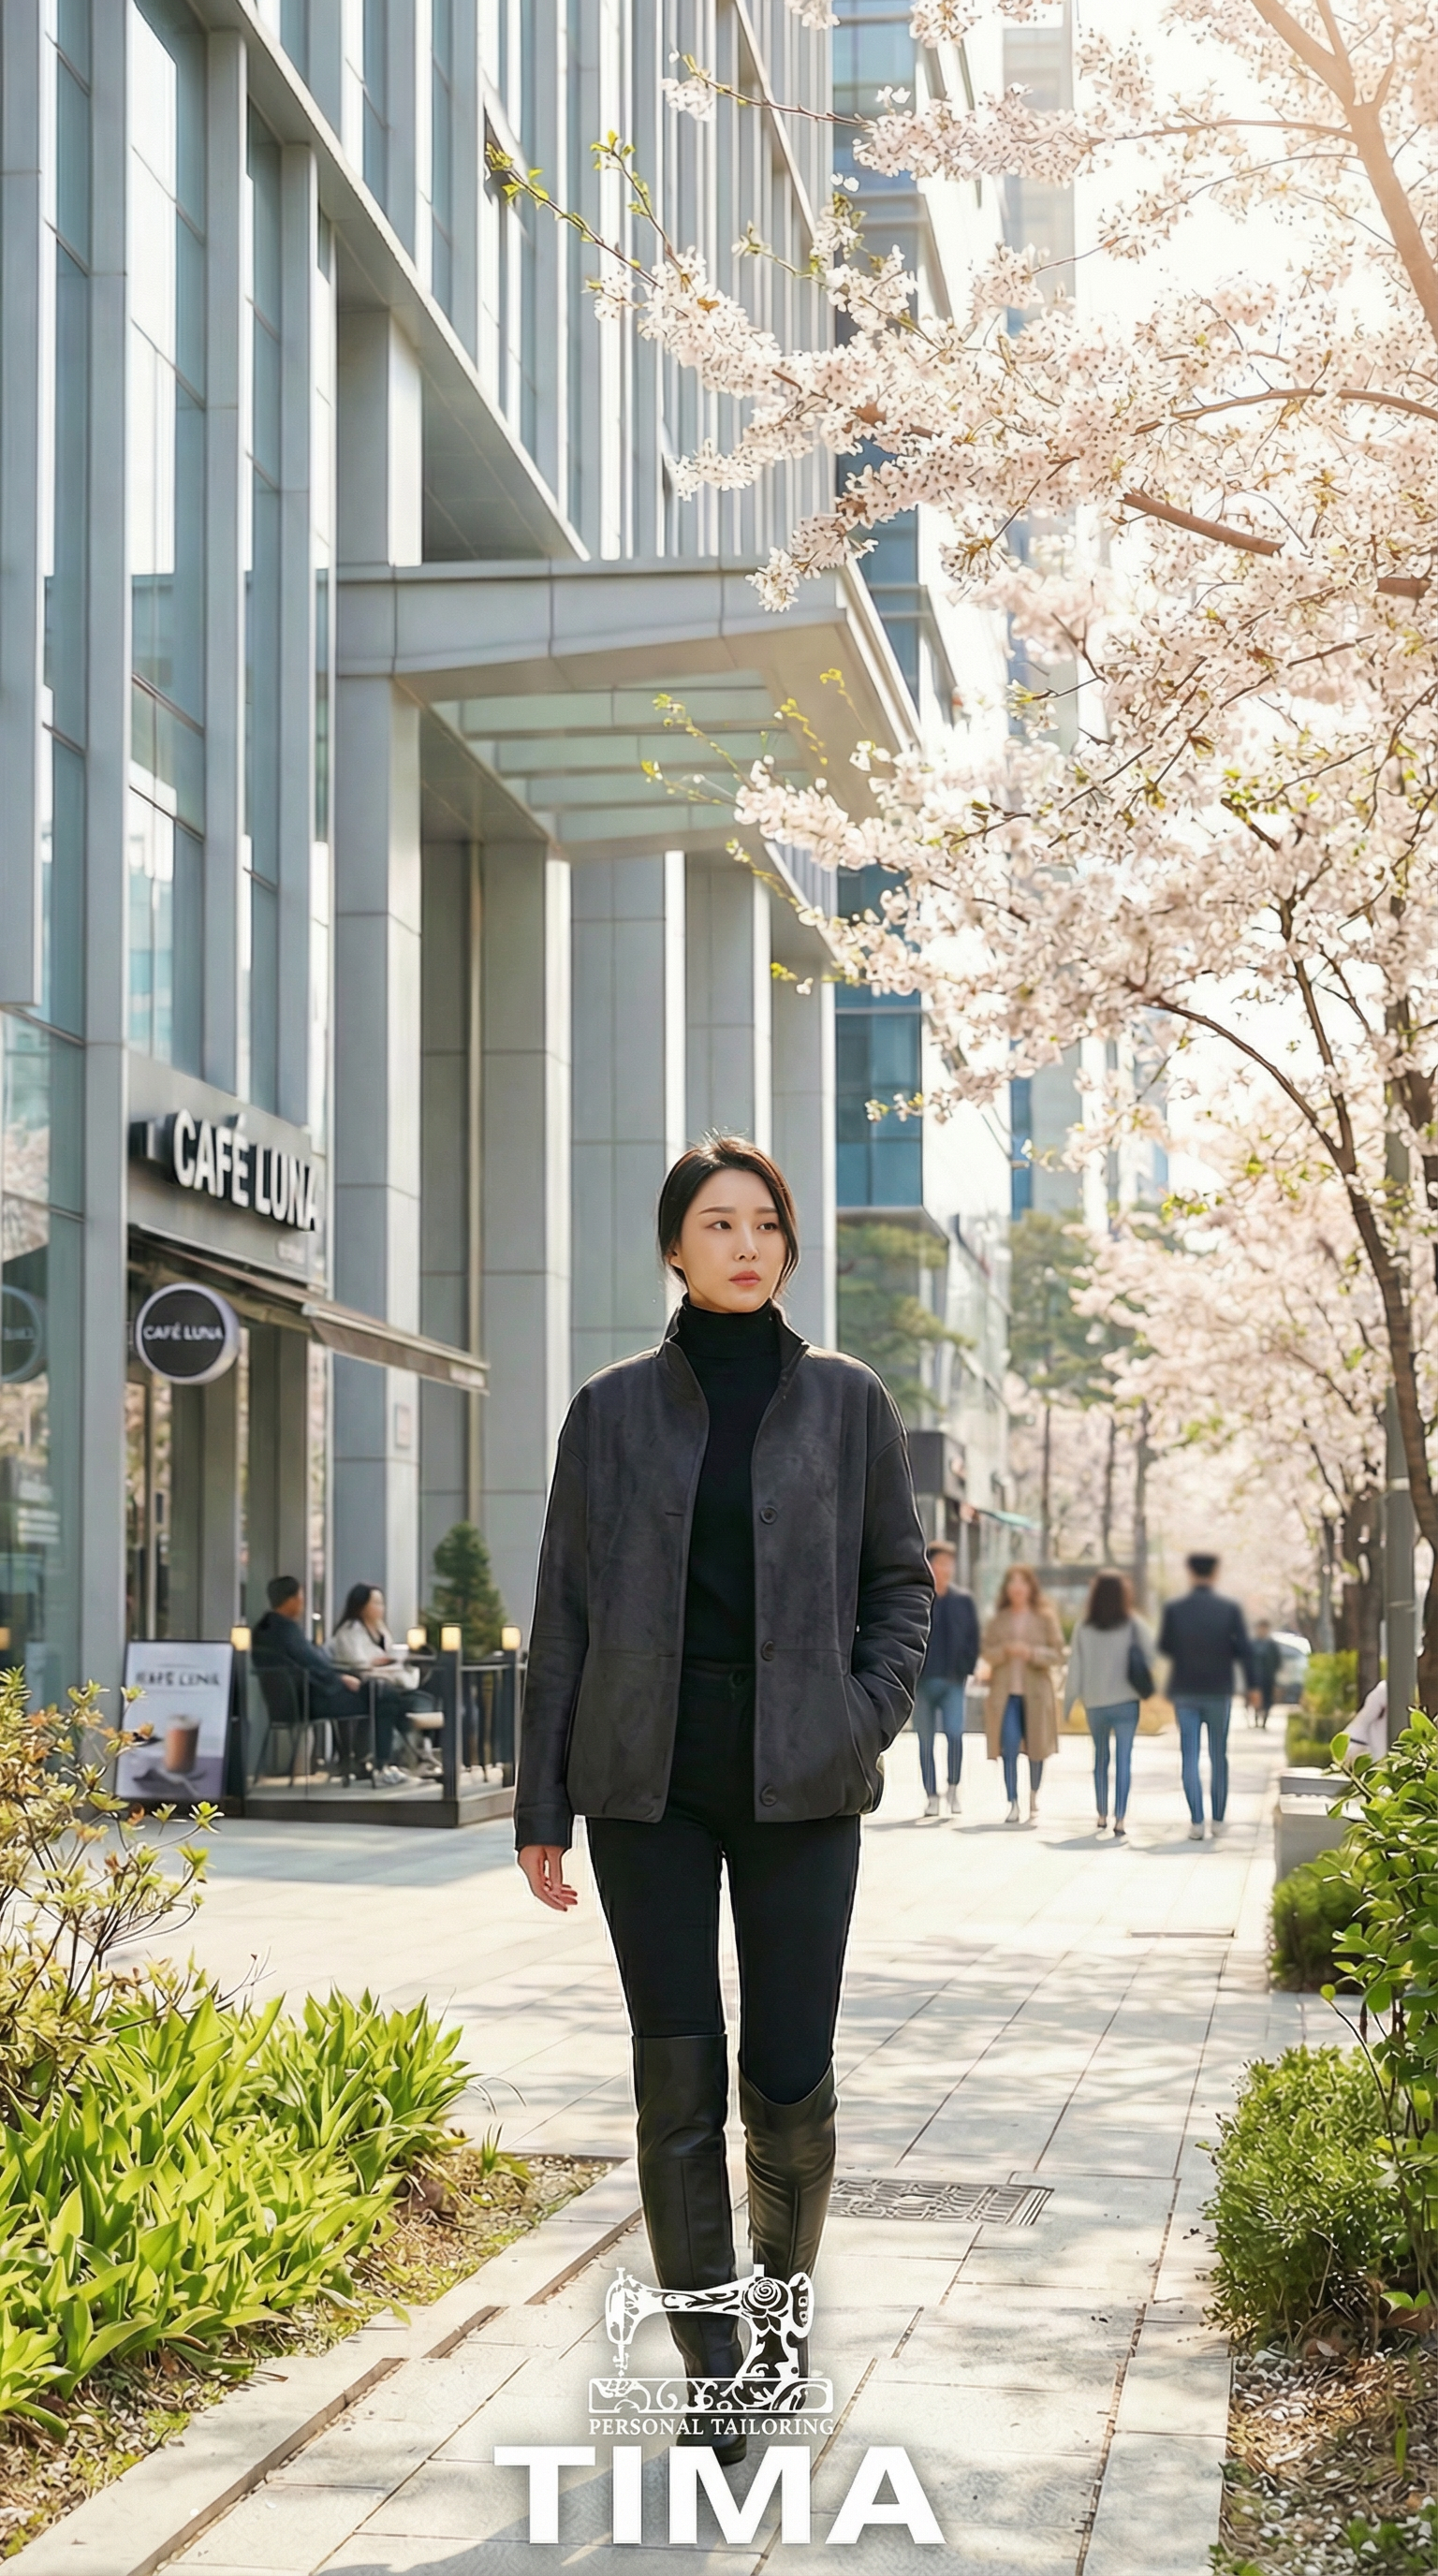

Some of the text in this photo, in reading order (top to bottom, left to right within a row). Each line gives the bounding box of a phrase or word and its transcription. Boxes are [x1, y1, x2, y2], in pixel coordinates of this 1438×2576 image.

[174, 1108, 323, 1234] CAFÉ LUNA
[183, 1325, 224, 1340] LUNA
